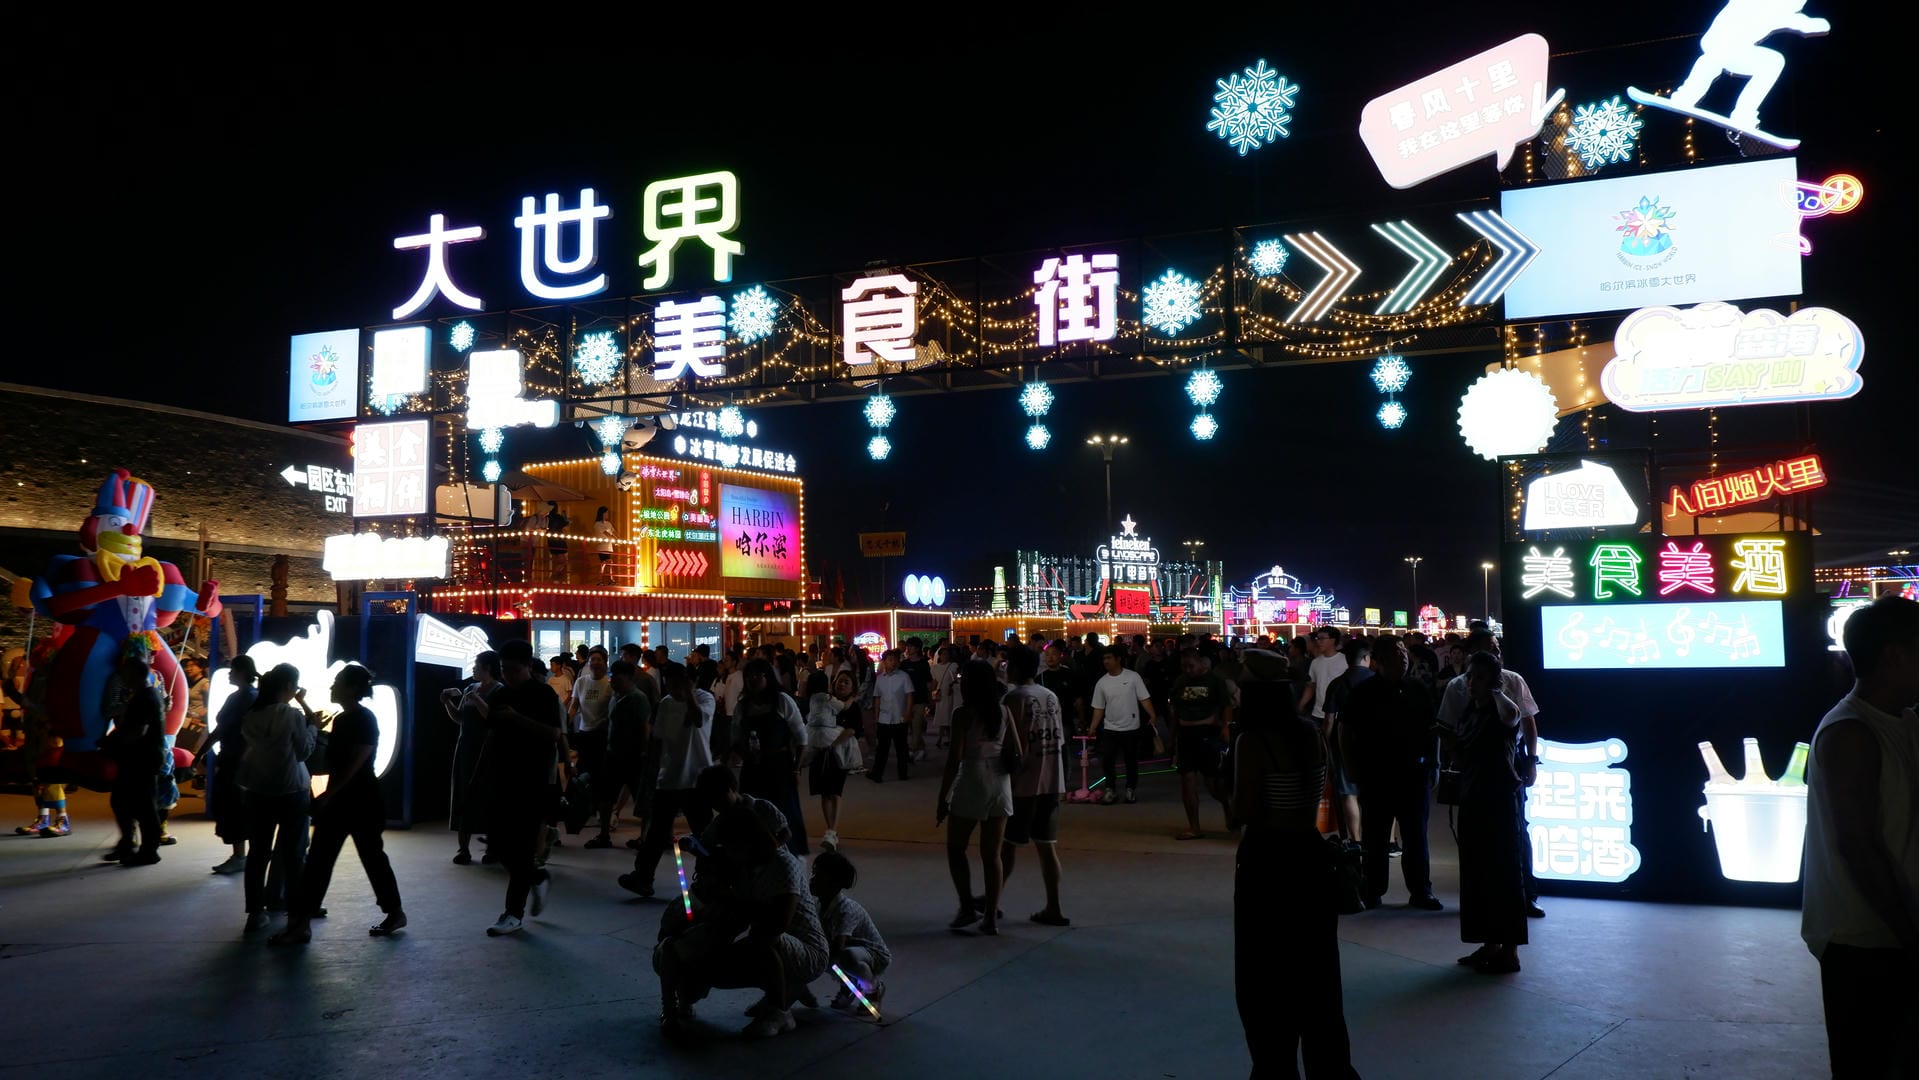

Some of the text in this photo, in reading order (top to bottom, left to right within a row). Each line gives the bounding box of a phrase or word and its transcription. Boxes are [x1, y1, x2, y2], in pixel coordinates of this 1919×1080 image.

[1388, 58, 1519, 133] 春风十里
[1396, 93, 1526, 160] 我在这里等你
[393, 171, 745, 320] 大世界
[654, 254, 1119, 381] 美食街
[1705, 362, 1764, 389] SAY
[1770, 359, 1802, 387] HI
[358, 427, 423, 466] 美食
[690, 438, 797, 473] 冰雪发展促进会
[325, 496, 347, 514] EXIT
[1544, 497, 1605, 518] BEER
[1555, 483, 1605, 501] LOVE
[1666, 457, 1826, 519] 人间烟火里
[732, 506, 784, 529] HARBIN
[736, 530, 787, 559] 哈尔滨
[1522, 539, 1787, 599] 美食美酒
[1530, 771, 1627, 822] 起来
[1531, 826, 1634, 877] 哈酒
